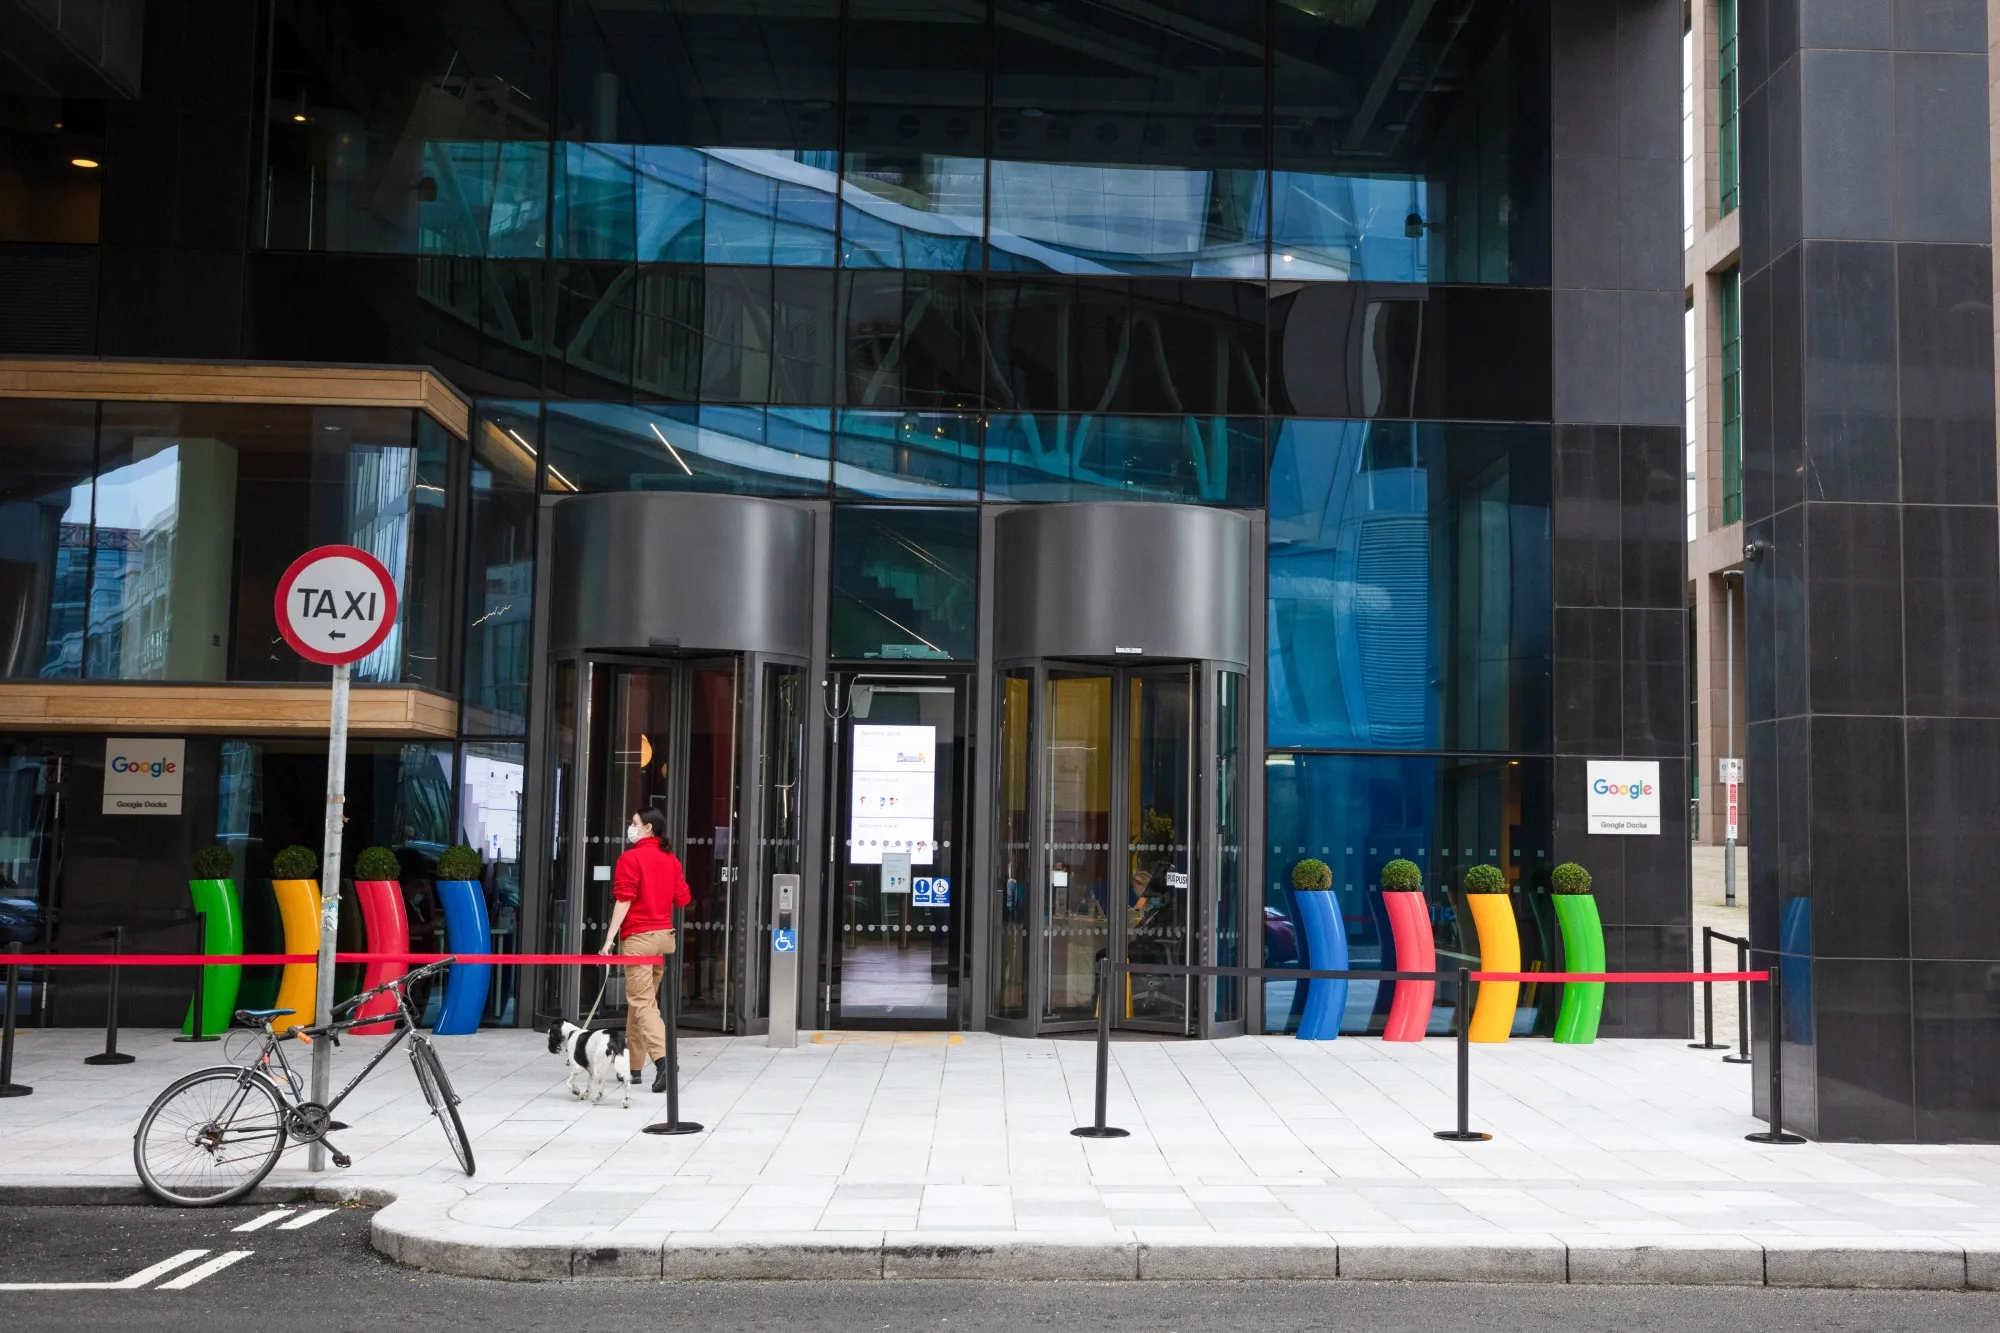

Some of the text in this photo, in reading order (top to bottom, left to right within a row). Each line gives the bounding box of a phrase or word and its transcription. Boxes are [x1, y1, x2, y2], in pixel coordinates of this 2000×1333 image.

[297, 588, 377, 621] TAXI
[112, 756, 176, 778] Google
[1593, 778, 1653, 800] Google
[1600, 821, 1625, 829] Google
